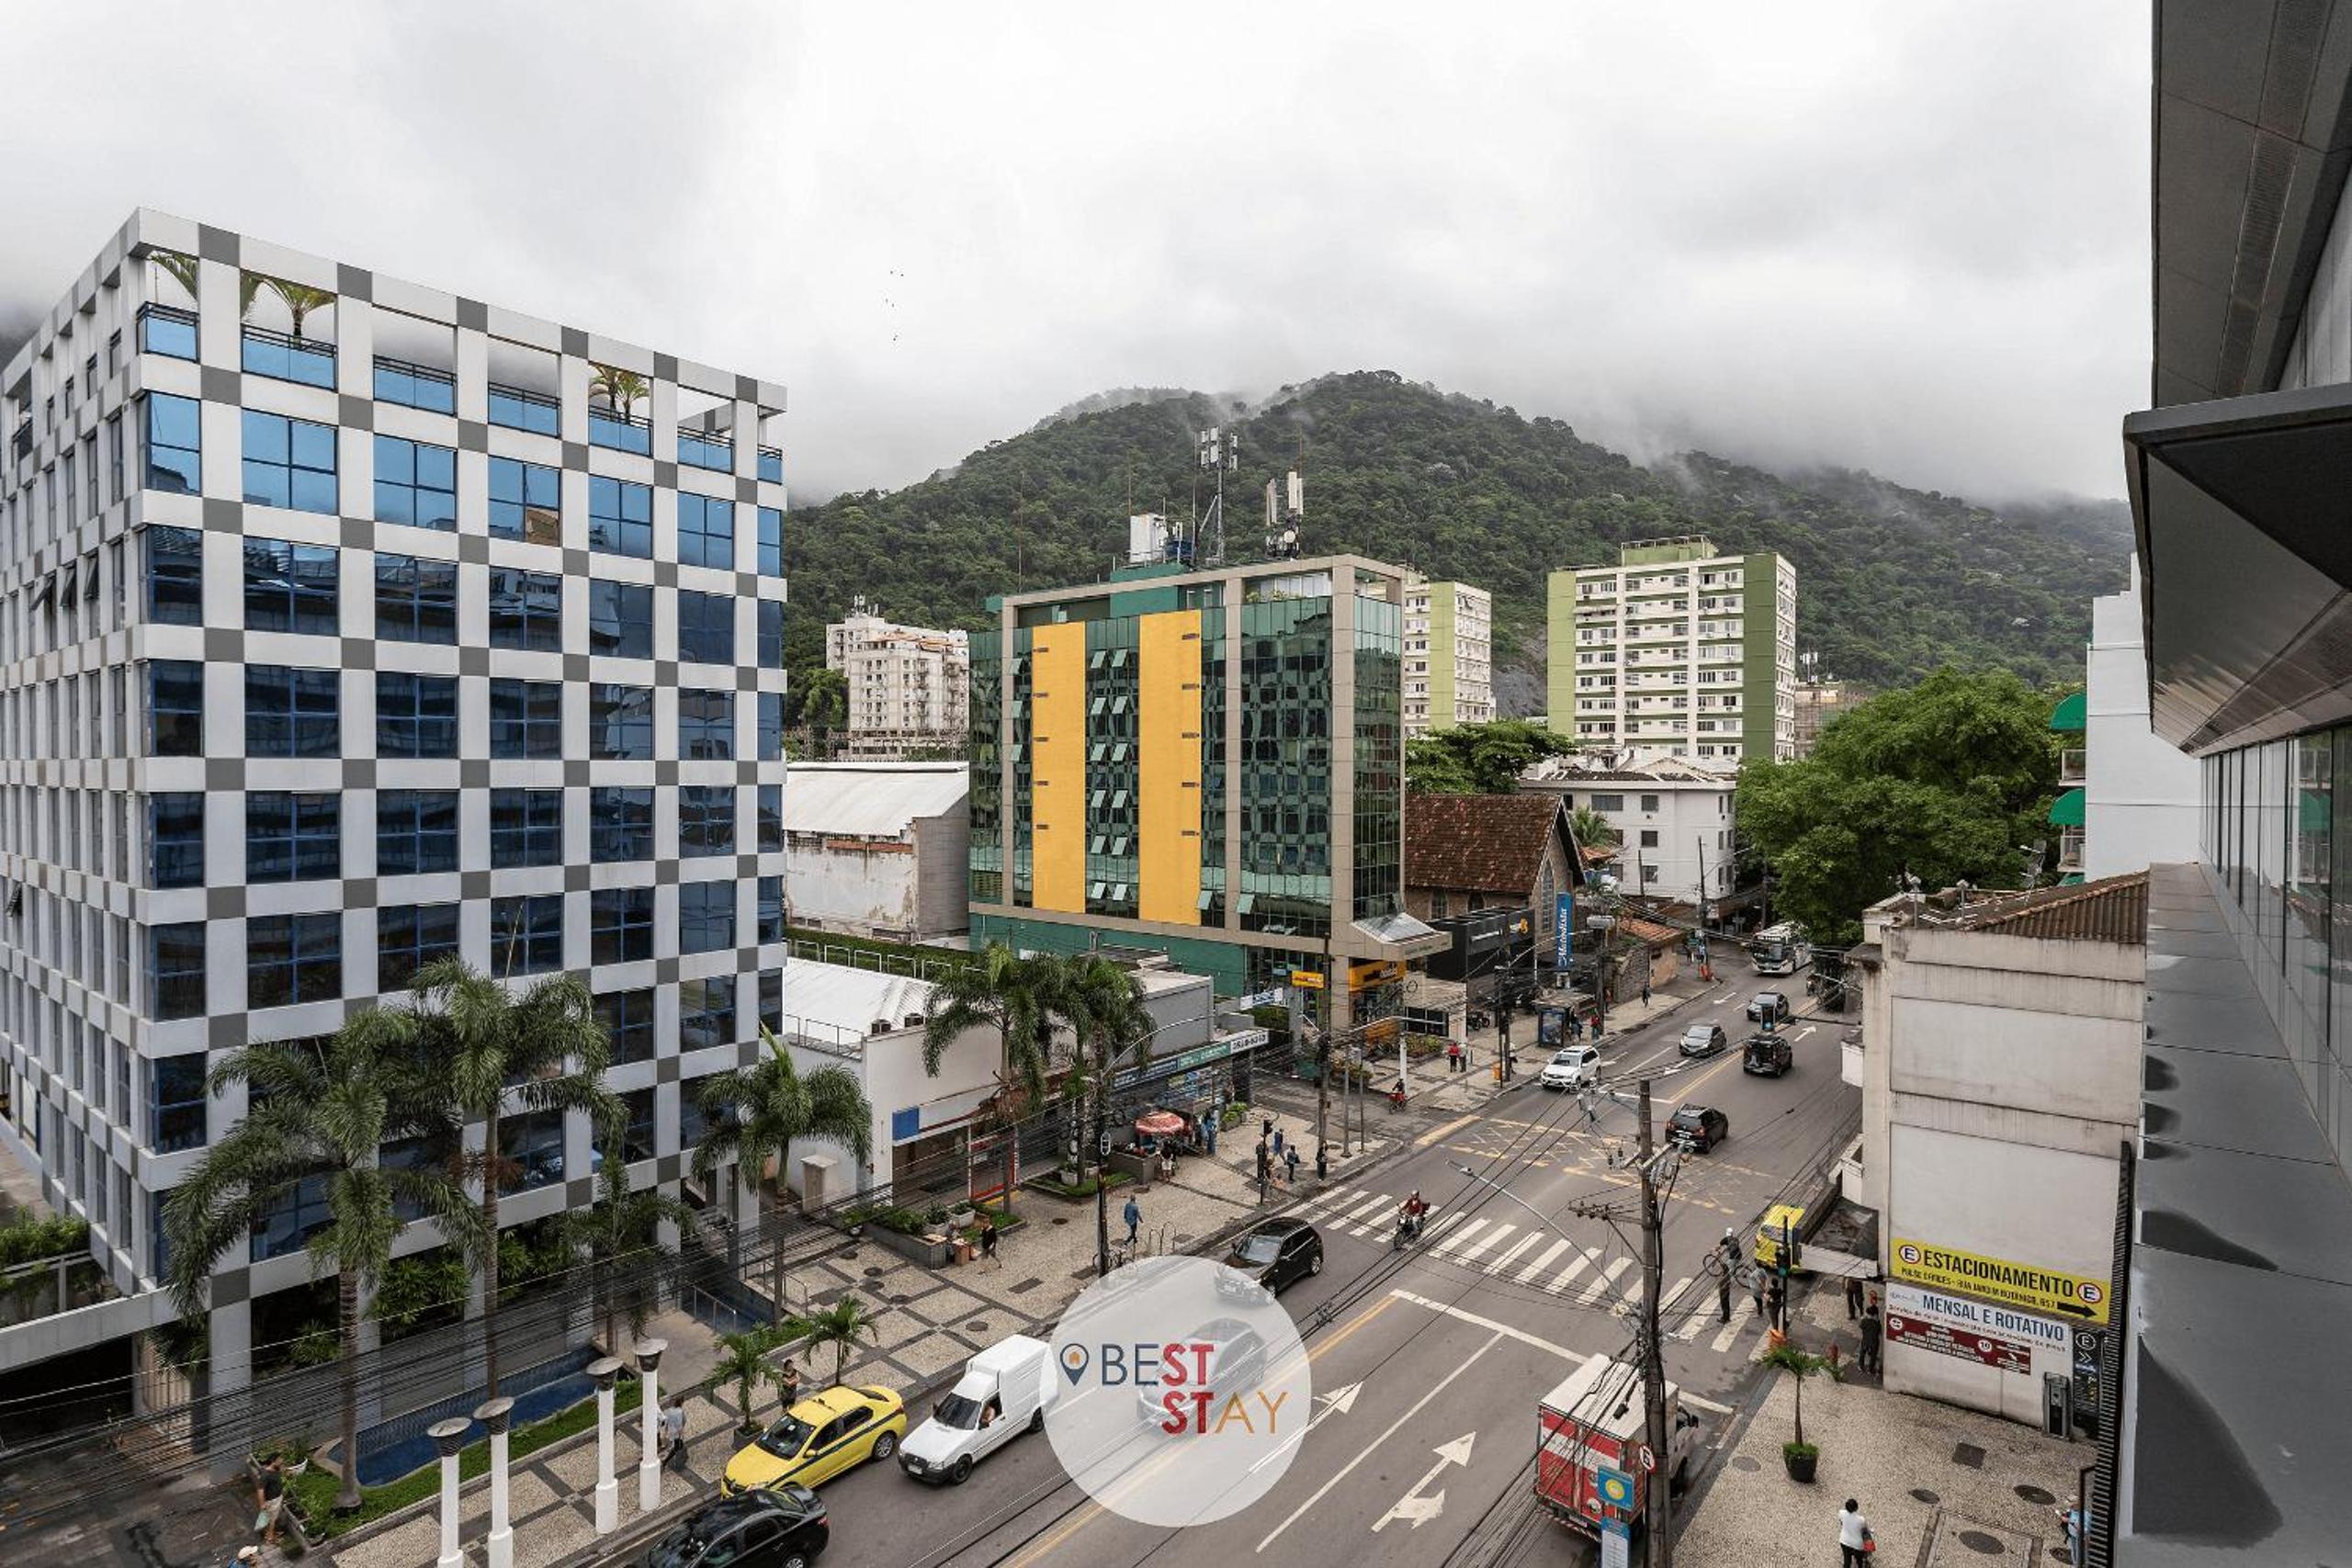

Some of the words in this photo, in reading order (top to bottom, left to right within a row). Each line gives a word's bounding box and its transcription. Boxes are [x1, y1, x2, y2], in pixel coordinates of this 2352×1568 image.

[1924, 1250, 2074, 1297] ESTACIONAMENTO
[1923, 1294, 1978, 1321] MENSAL
[1983, 1308, 1991, 1323] E
[1996, 1312, 2064, 1341] ROTATIVO
